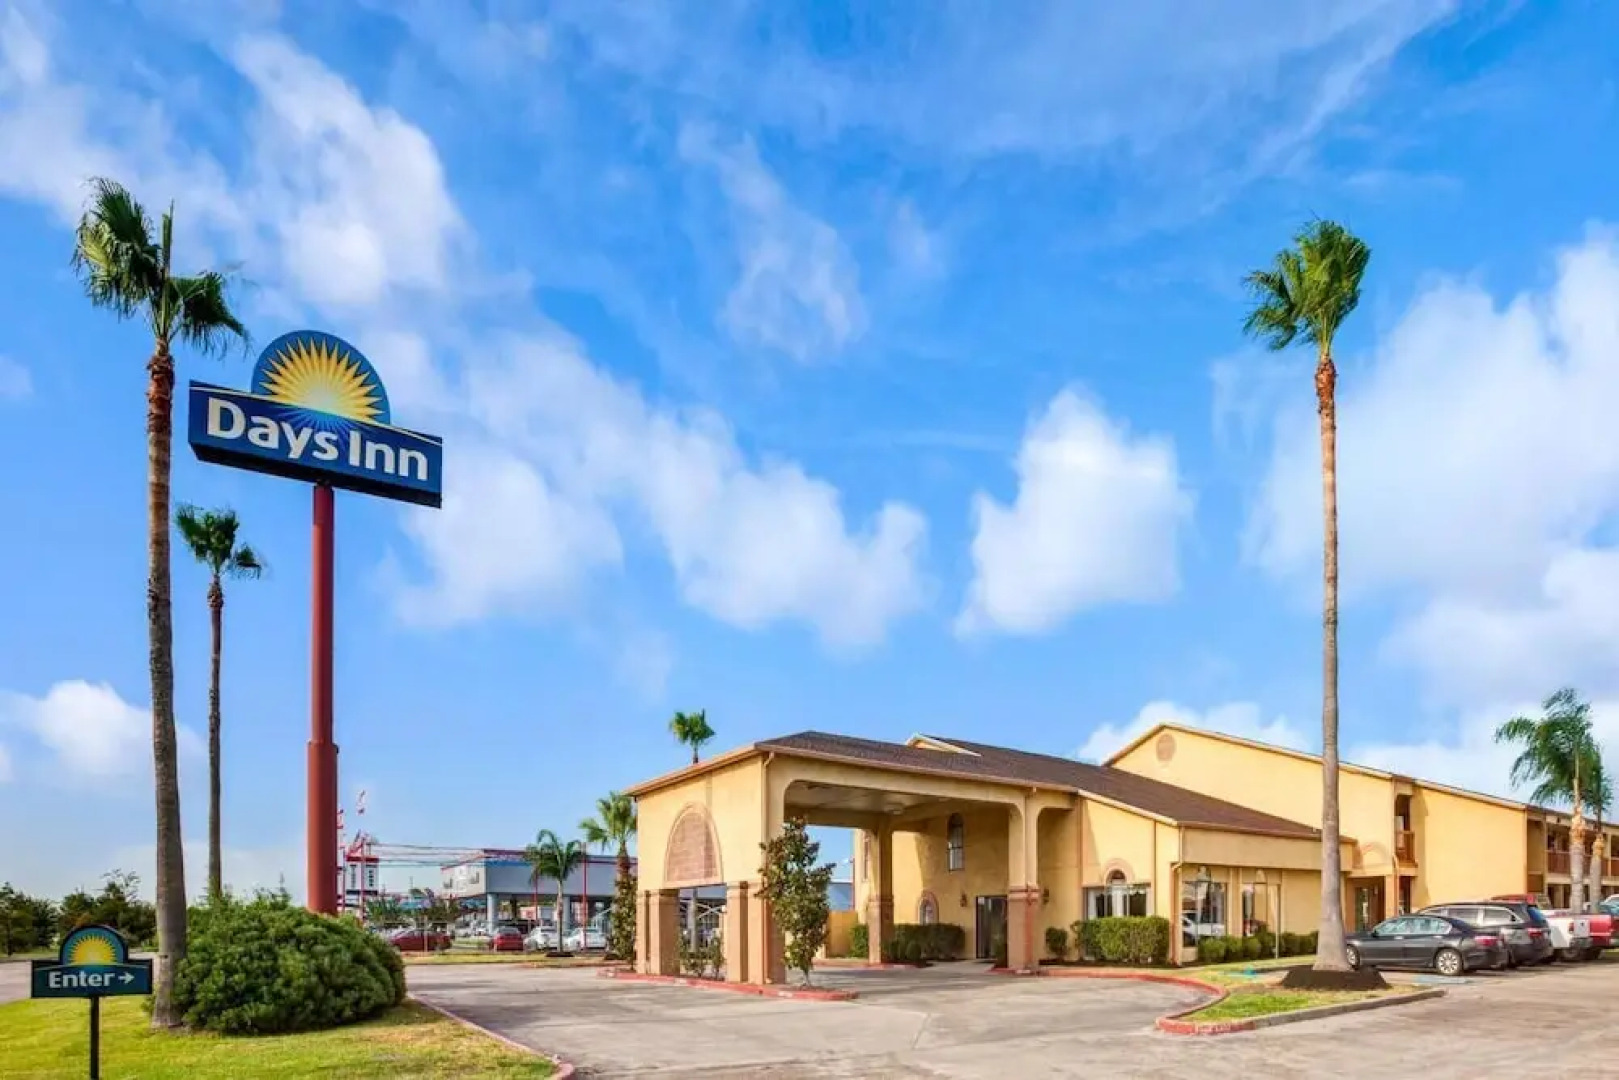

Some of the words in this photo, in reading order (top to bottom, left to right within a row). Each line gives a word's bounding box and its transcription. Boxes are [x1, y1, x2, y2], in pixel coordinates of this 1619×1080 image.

[207, 397, 339, 461] Days
[349, 430, 428, 481] Inn
[48, 970, 115, 988] Enter
